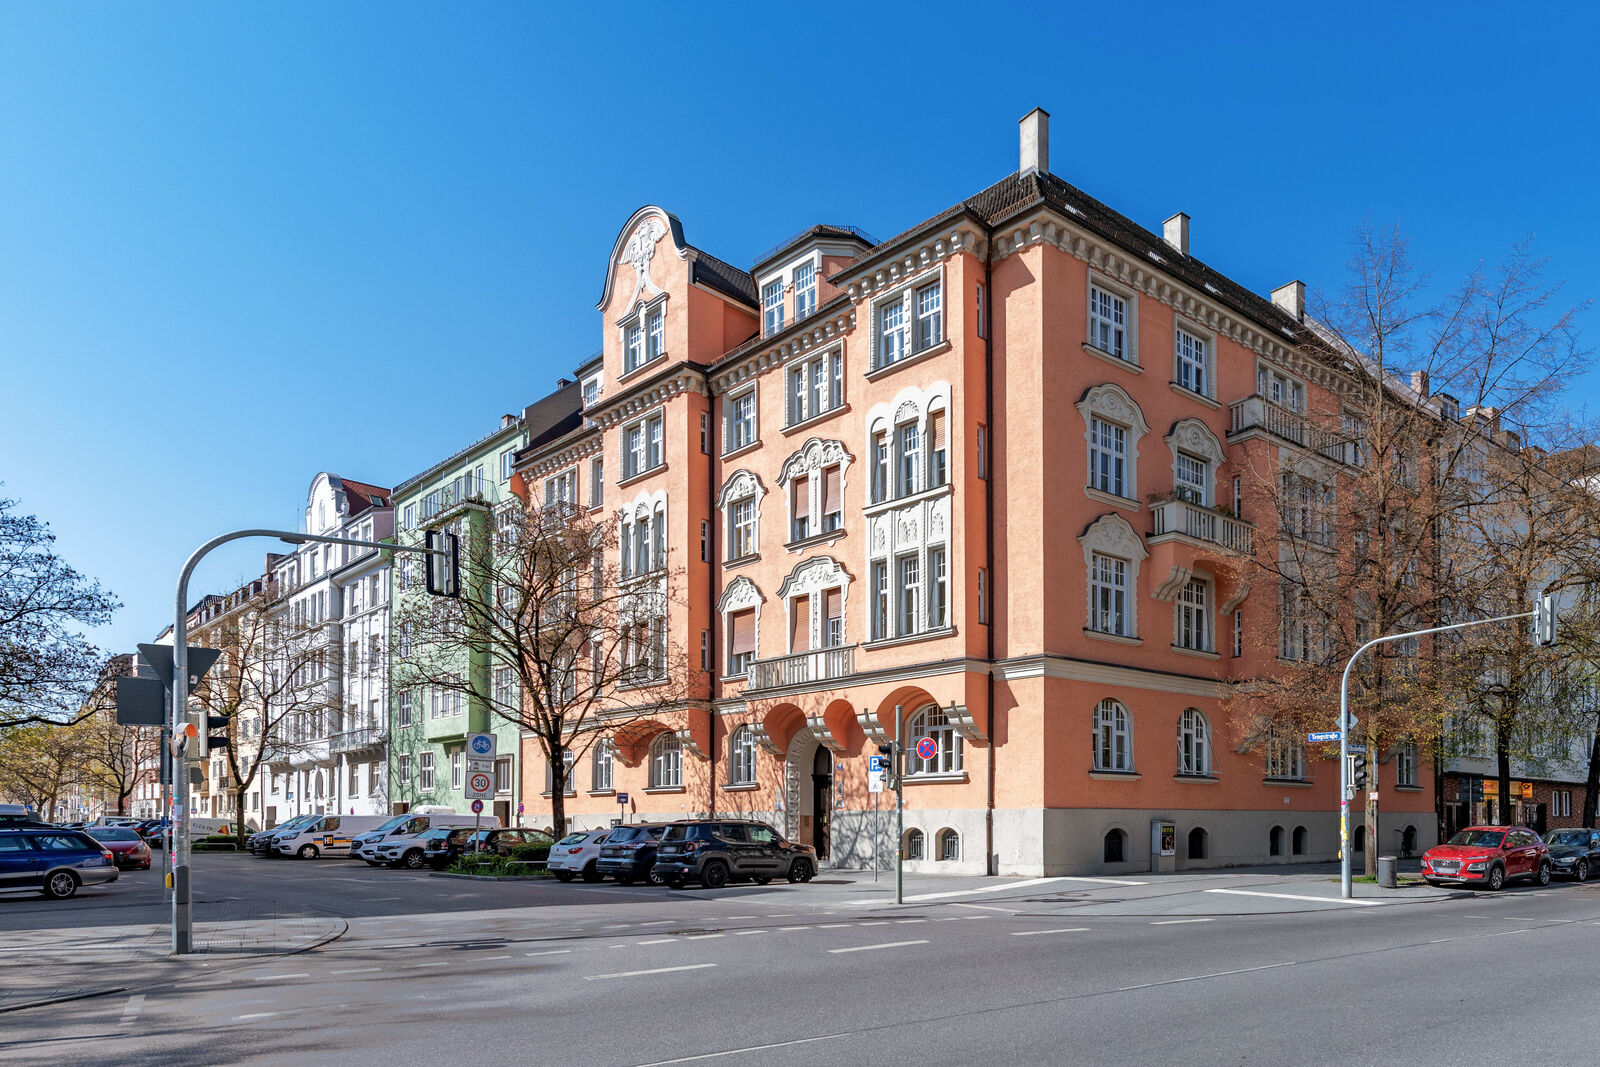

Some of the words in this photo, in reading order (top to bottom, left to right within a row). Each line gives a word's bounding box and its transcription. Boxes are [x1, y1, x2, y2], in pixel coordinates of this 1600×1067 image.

[871, 758, 879, 770] P
[475, 778, 486, 787] 30
[193, 823, 216, 832] ELEKTRO
